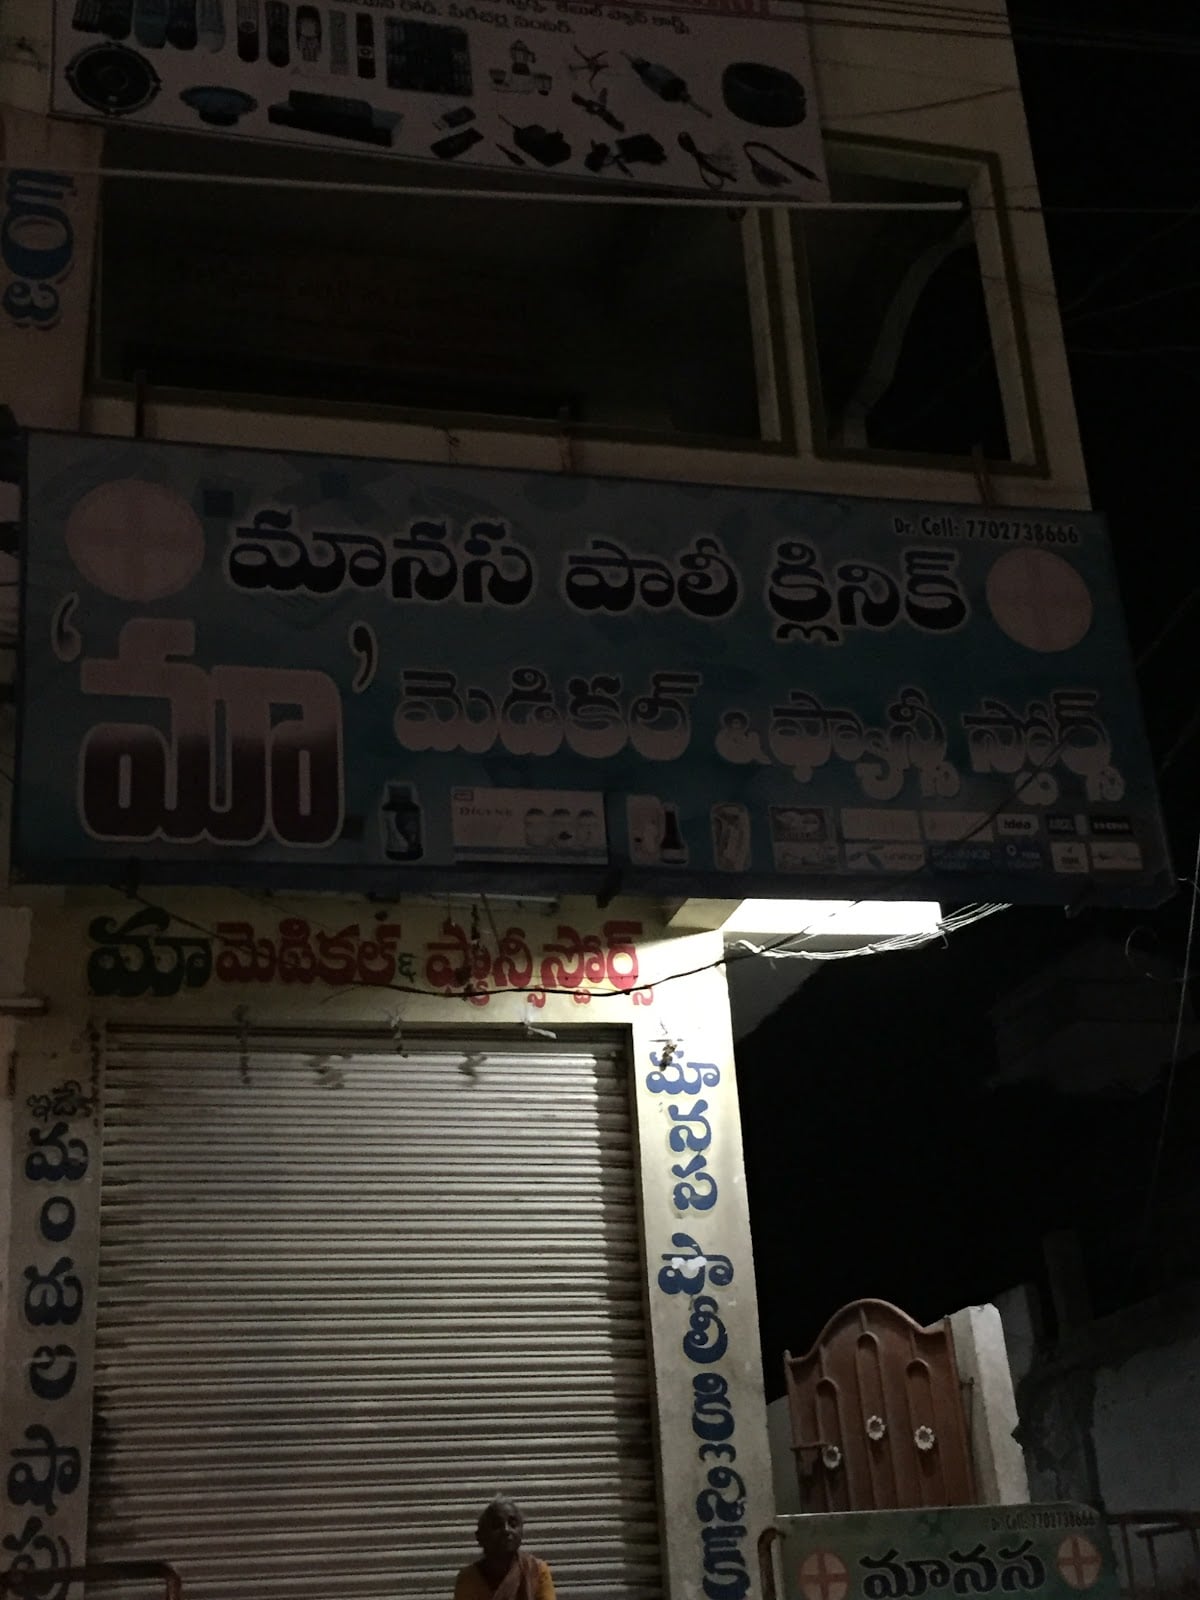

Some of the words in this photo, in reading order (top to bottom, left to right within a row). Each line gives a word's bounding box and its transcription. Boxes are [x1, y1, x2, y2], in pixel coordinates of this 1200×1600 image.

[228, 508, 534, 605] మానస
[564, 537, 739, 617] పాలీ
[768, 541, 968, 642] క్లినిక్
[894, 517, 916, 534] Dr.
[921, 516, 960, 538] Cell:
[966, 519, 1080, 545] 7702738666
[394, 667, 703, 762] మెడికల్
[715, 709, 773, 766] &
[769, 686, 962, 801] ఫ్యాన్సీ
[961, 689, 1126, 805] స్టోర్స్
[87, 907, 213, 997] మా
[216, 917, 402, 986] మెడికల్
[540, 919, 655, 1007] స్టోర్స్
[859, 1540, 1046, 1600] మానస
